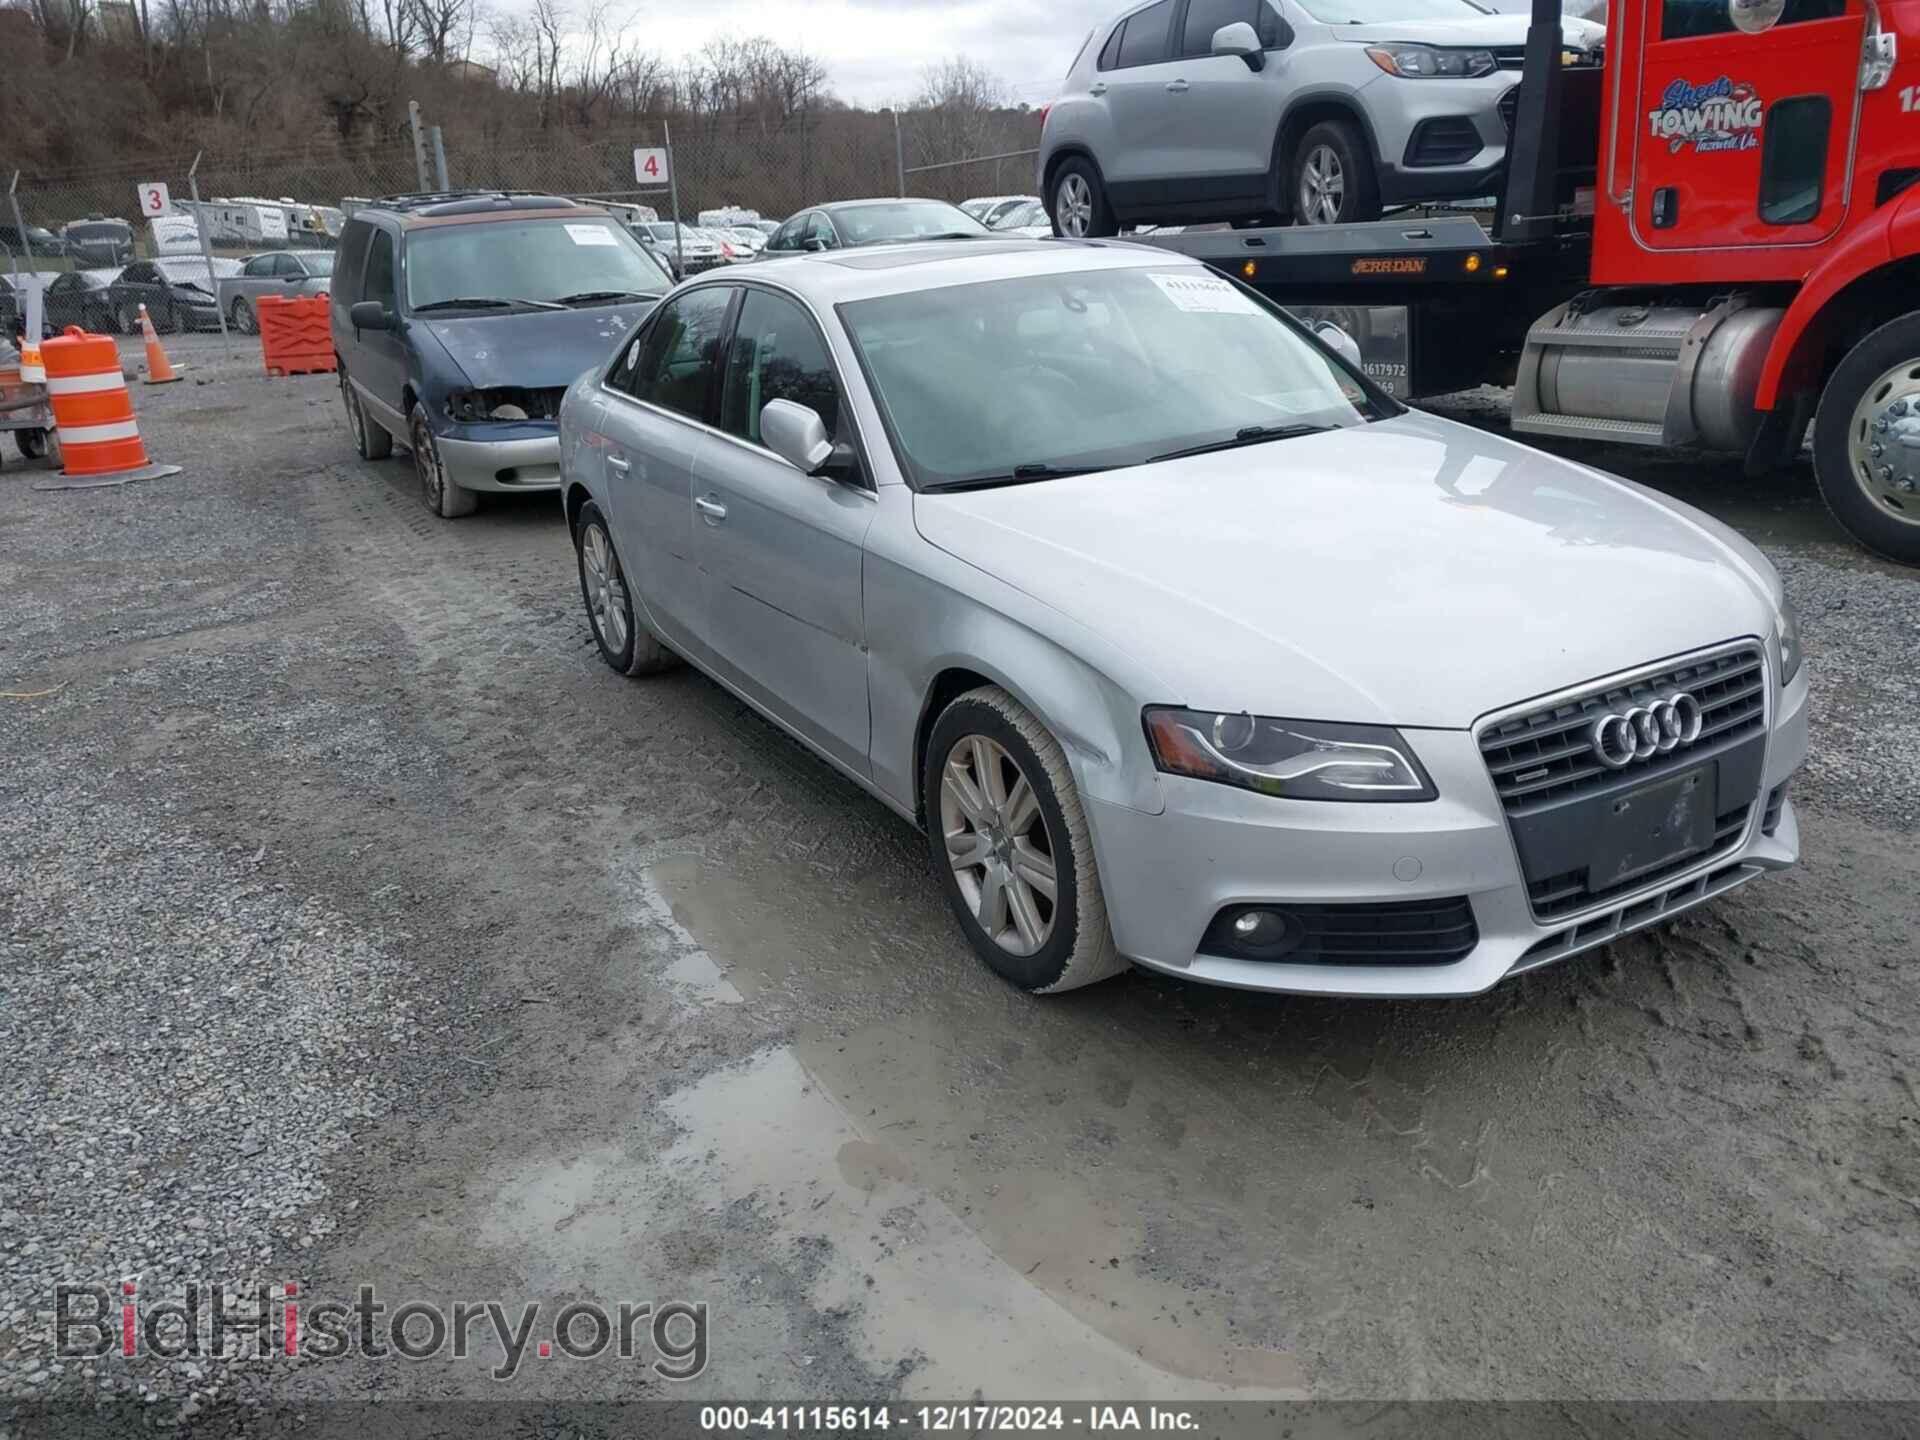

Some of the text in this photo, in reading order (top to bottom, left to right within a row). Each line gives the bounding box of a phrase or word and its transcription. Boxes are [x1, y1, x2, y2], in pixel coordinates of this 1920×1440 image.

[1649, 97, 1762, 137] TOWING
[643, 155, 659, 176] 4
[148, 190, 162, 209] 3
